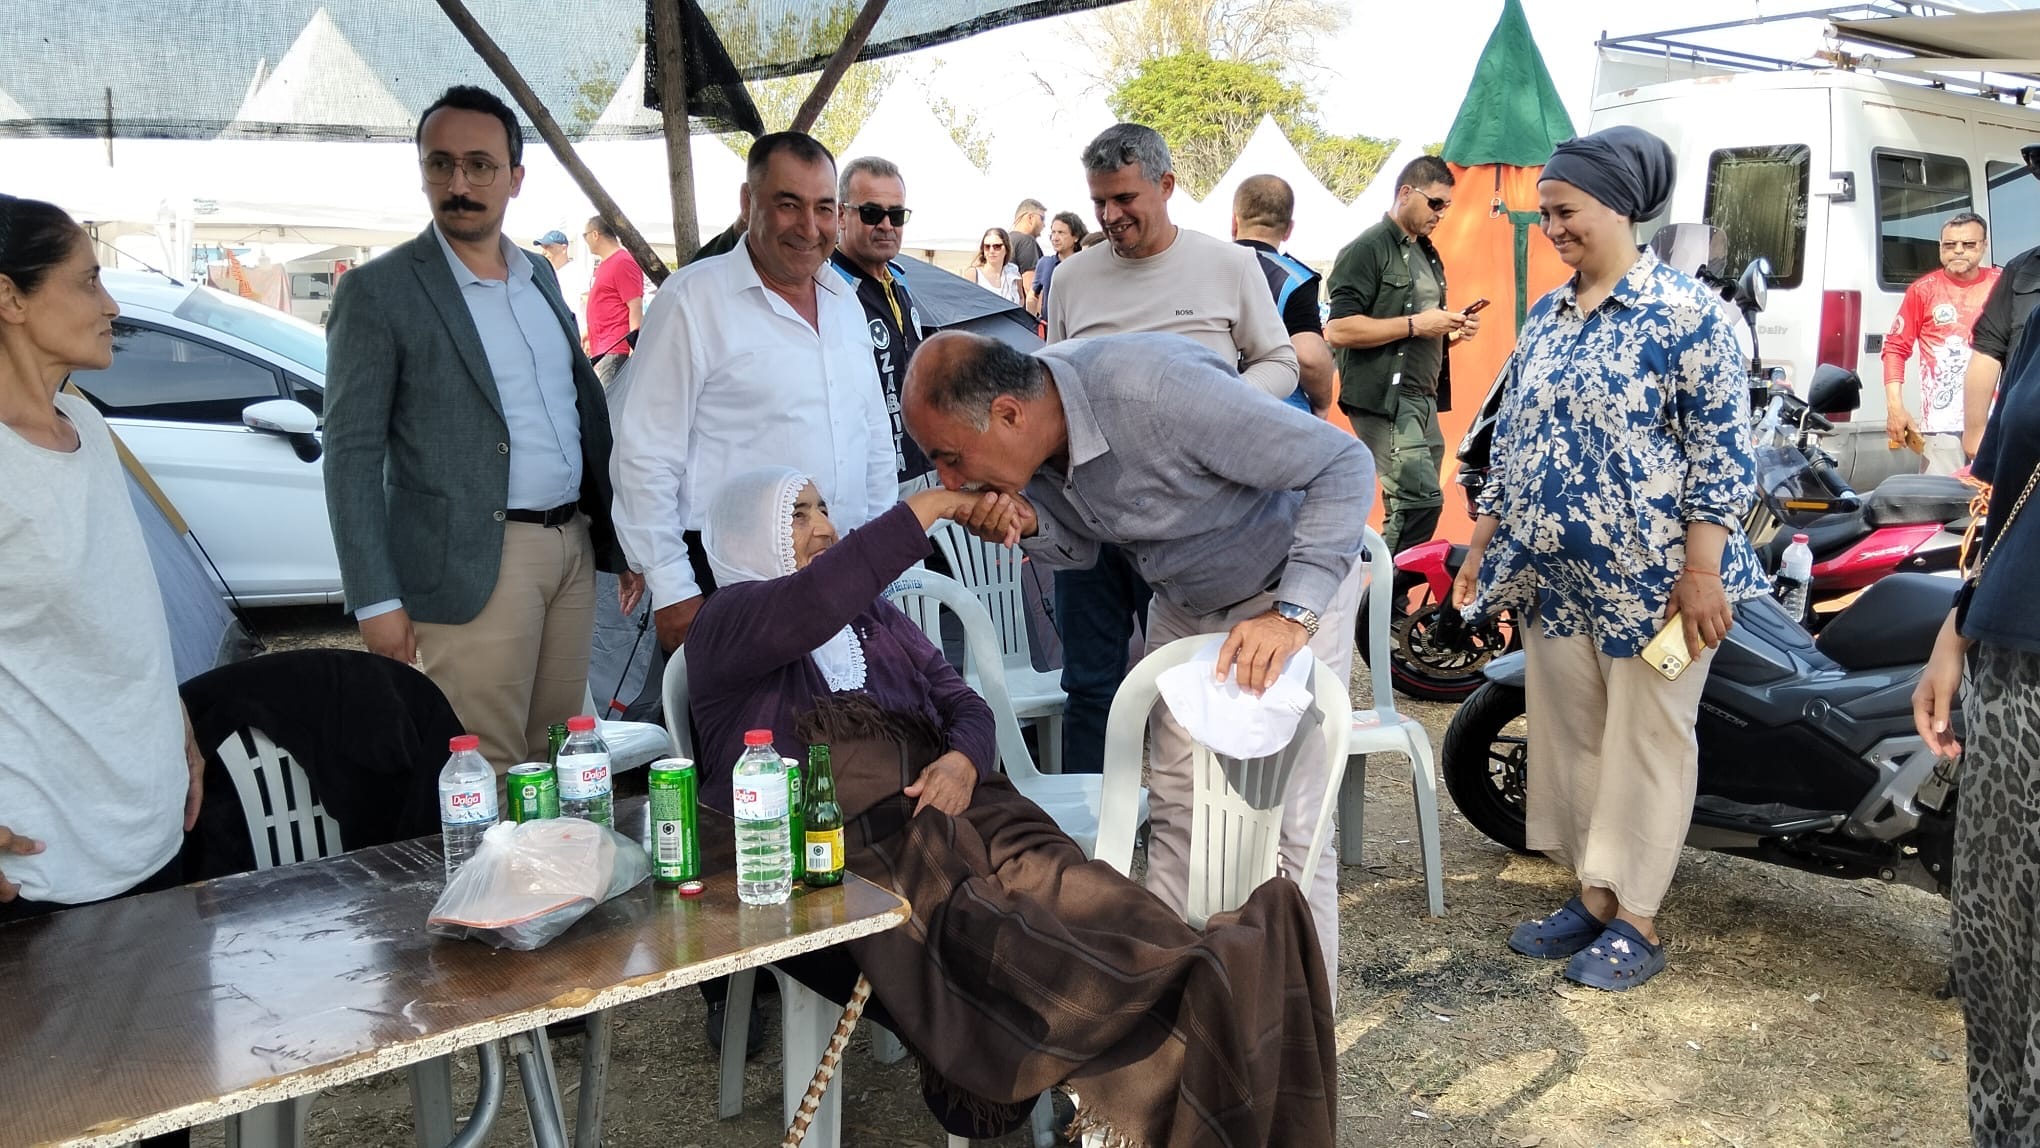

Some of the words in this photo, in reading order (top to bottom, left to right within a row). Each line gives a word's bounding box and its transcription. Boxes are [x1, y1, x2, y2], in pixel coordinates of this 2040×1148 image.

[880, 351, 907, 473] ZABITA
[583, 768, 607, 781] Dalga
[452, 794, 479, 806] Dalga
[736, 789, 756, 803] Dalga
